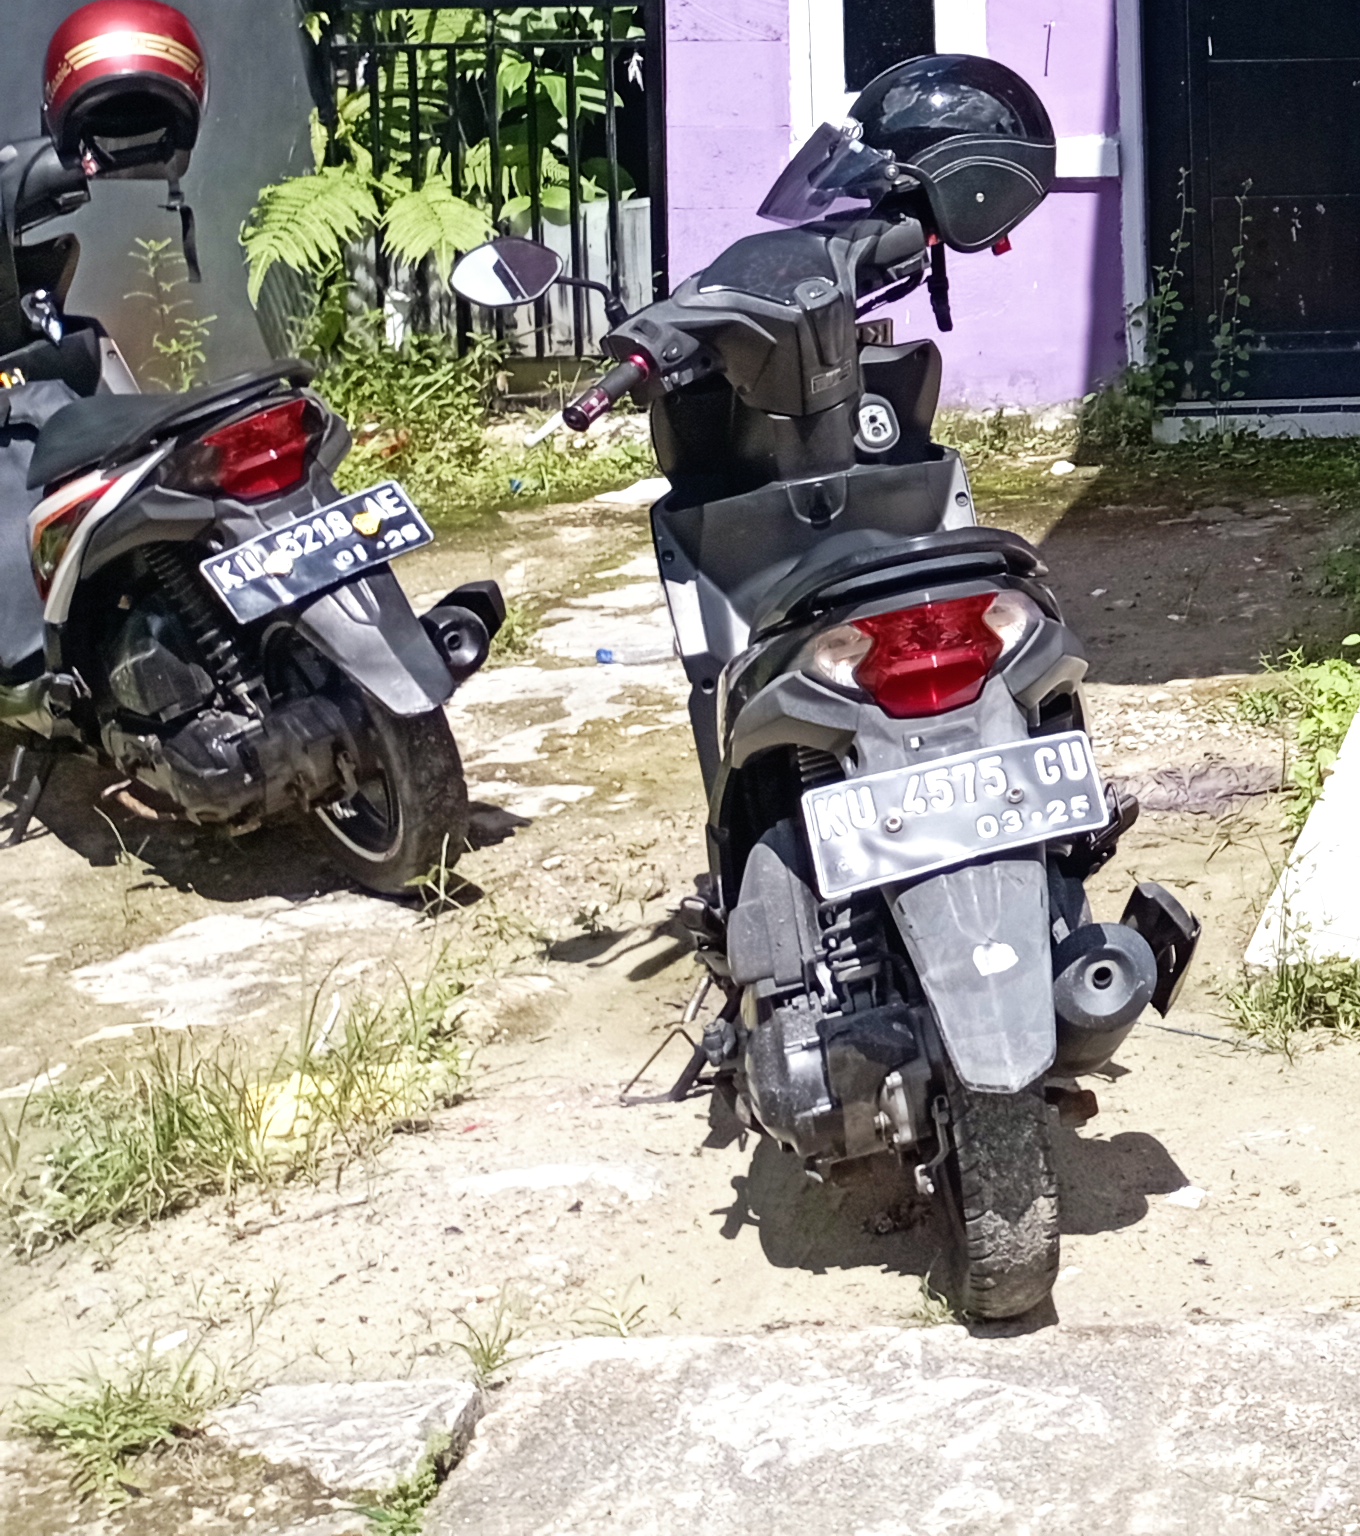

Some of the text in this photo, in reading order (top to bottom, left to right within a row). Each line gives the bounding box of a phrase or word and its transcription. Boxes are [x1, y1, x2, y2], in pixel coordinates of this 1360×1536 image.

[212, 548, 266, 594] KU
[813, 785, 877, 842] KU
[901, 755, 1008, 815] 4575
